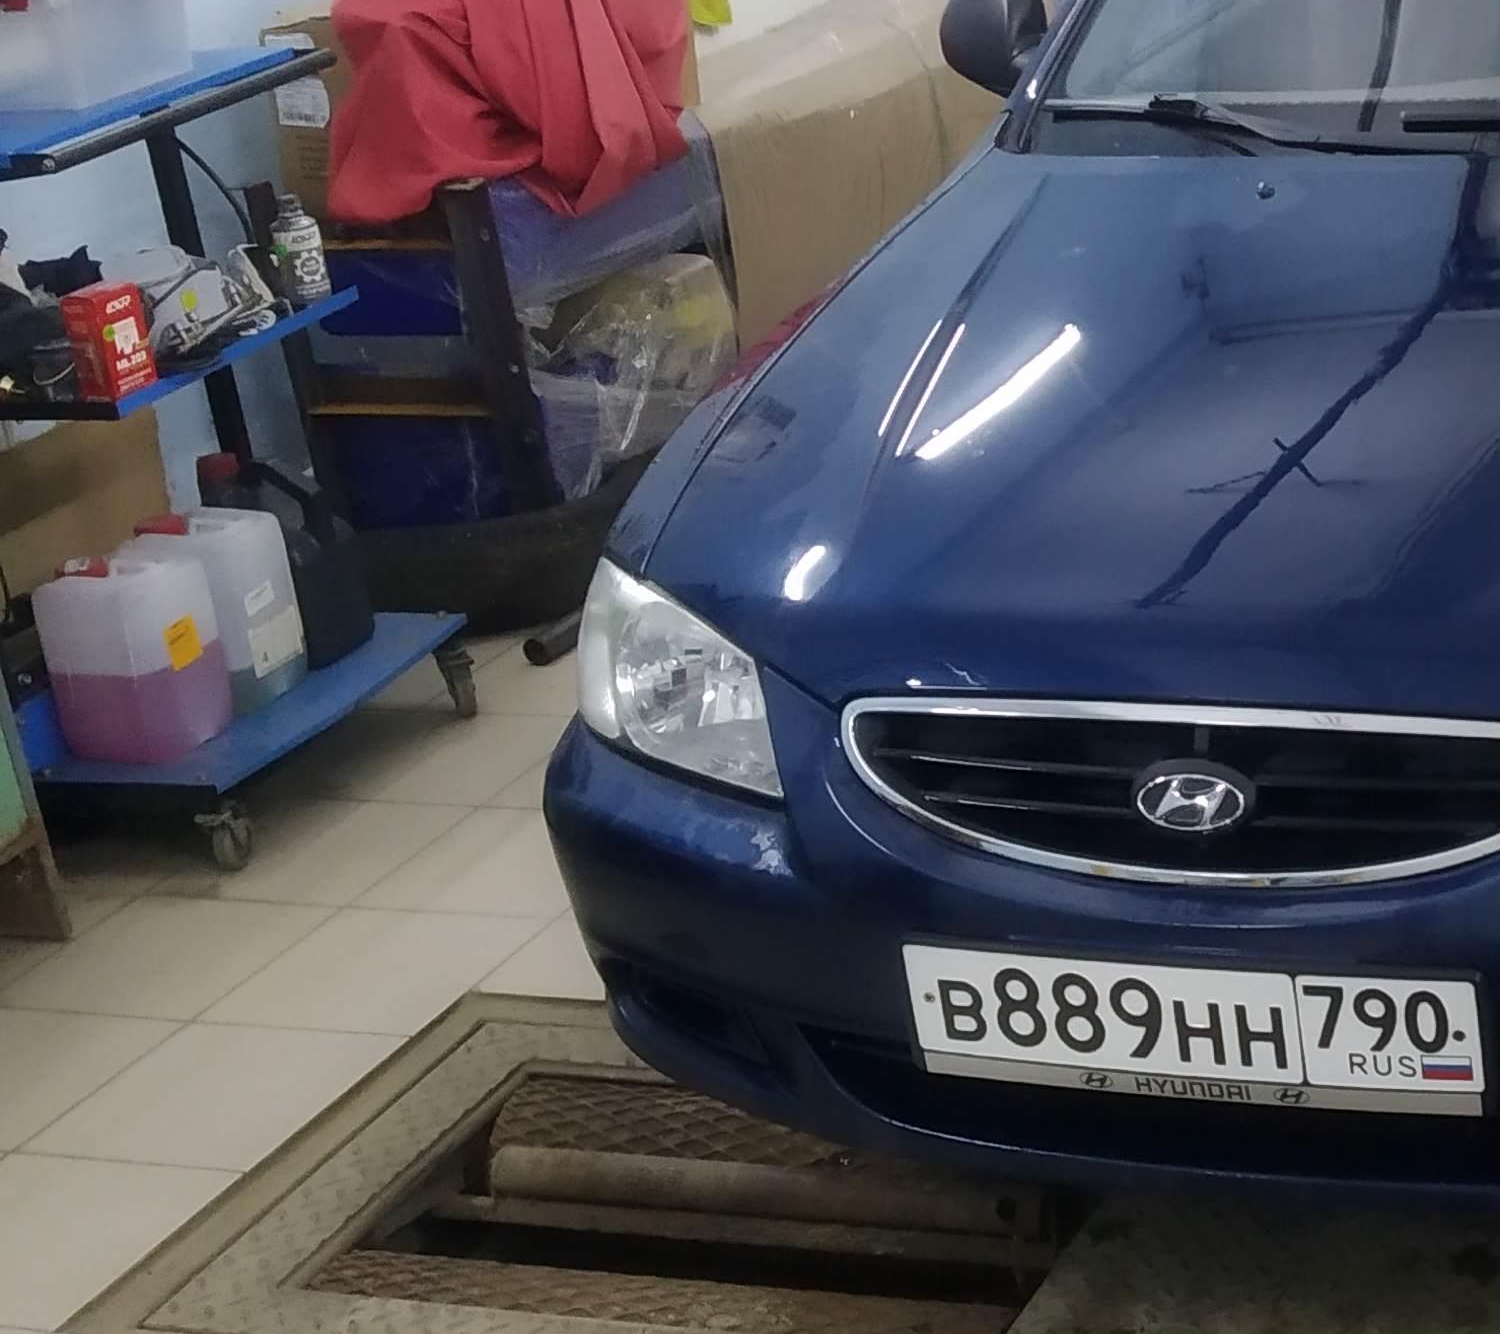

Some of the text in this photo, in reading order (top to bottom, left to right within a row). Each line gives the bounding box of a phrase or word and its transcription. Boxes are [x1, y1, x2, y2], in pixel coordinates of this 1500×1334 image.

[936, 968, 1289, 1070] В889НН
[1301, 985, 1450, 1054] 790
[1134, 1076, 1252, 1102] HYUNDAI
[1348, 1053, 1417, 1078] RUS
